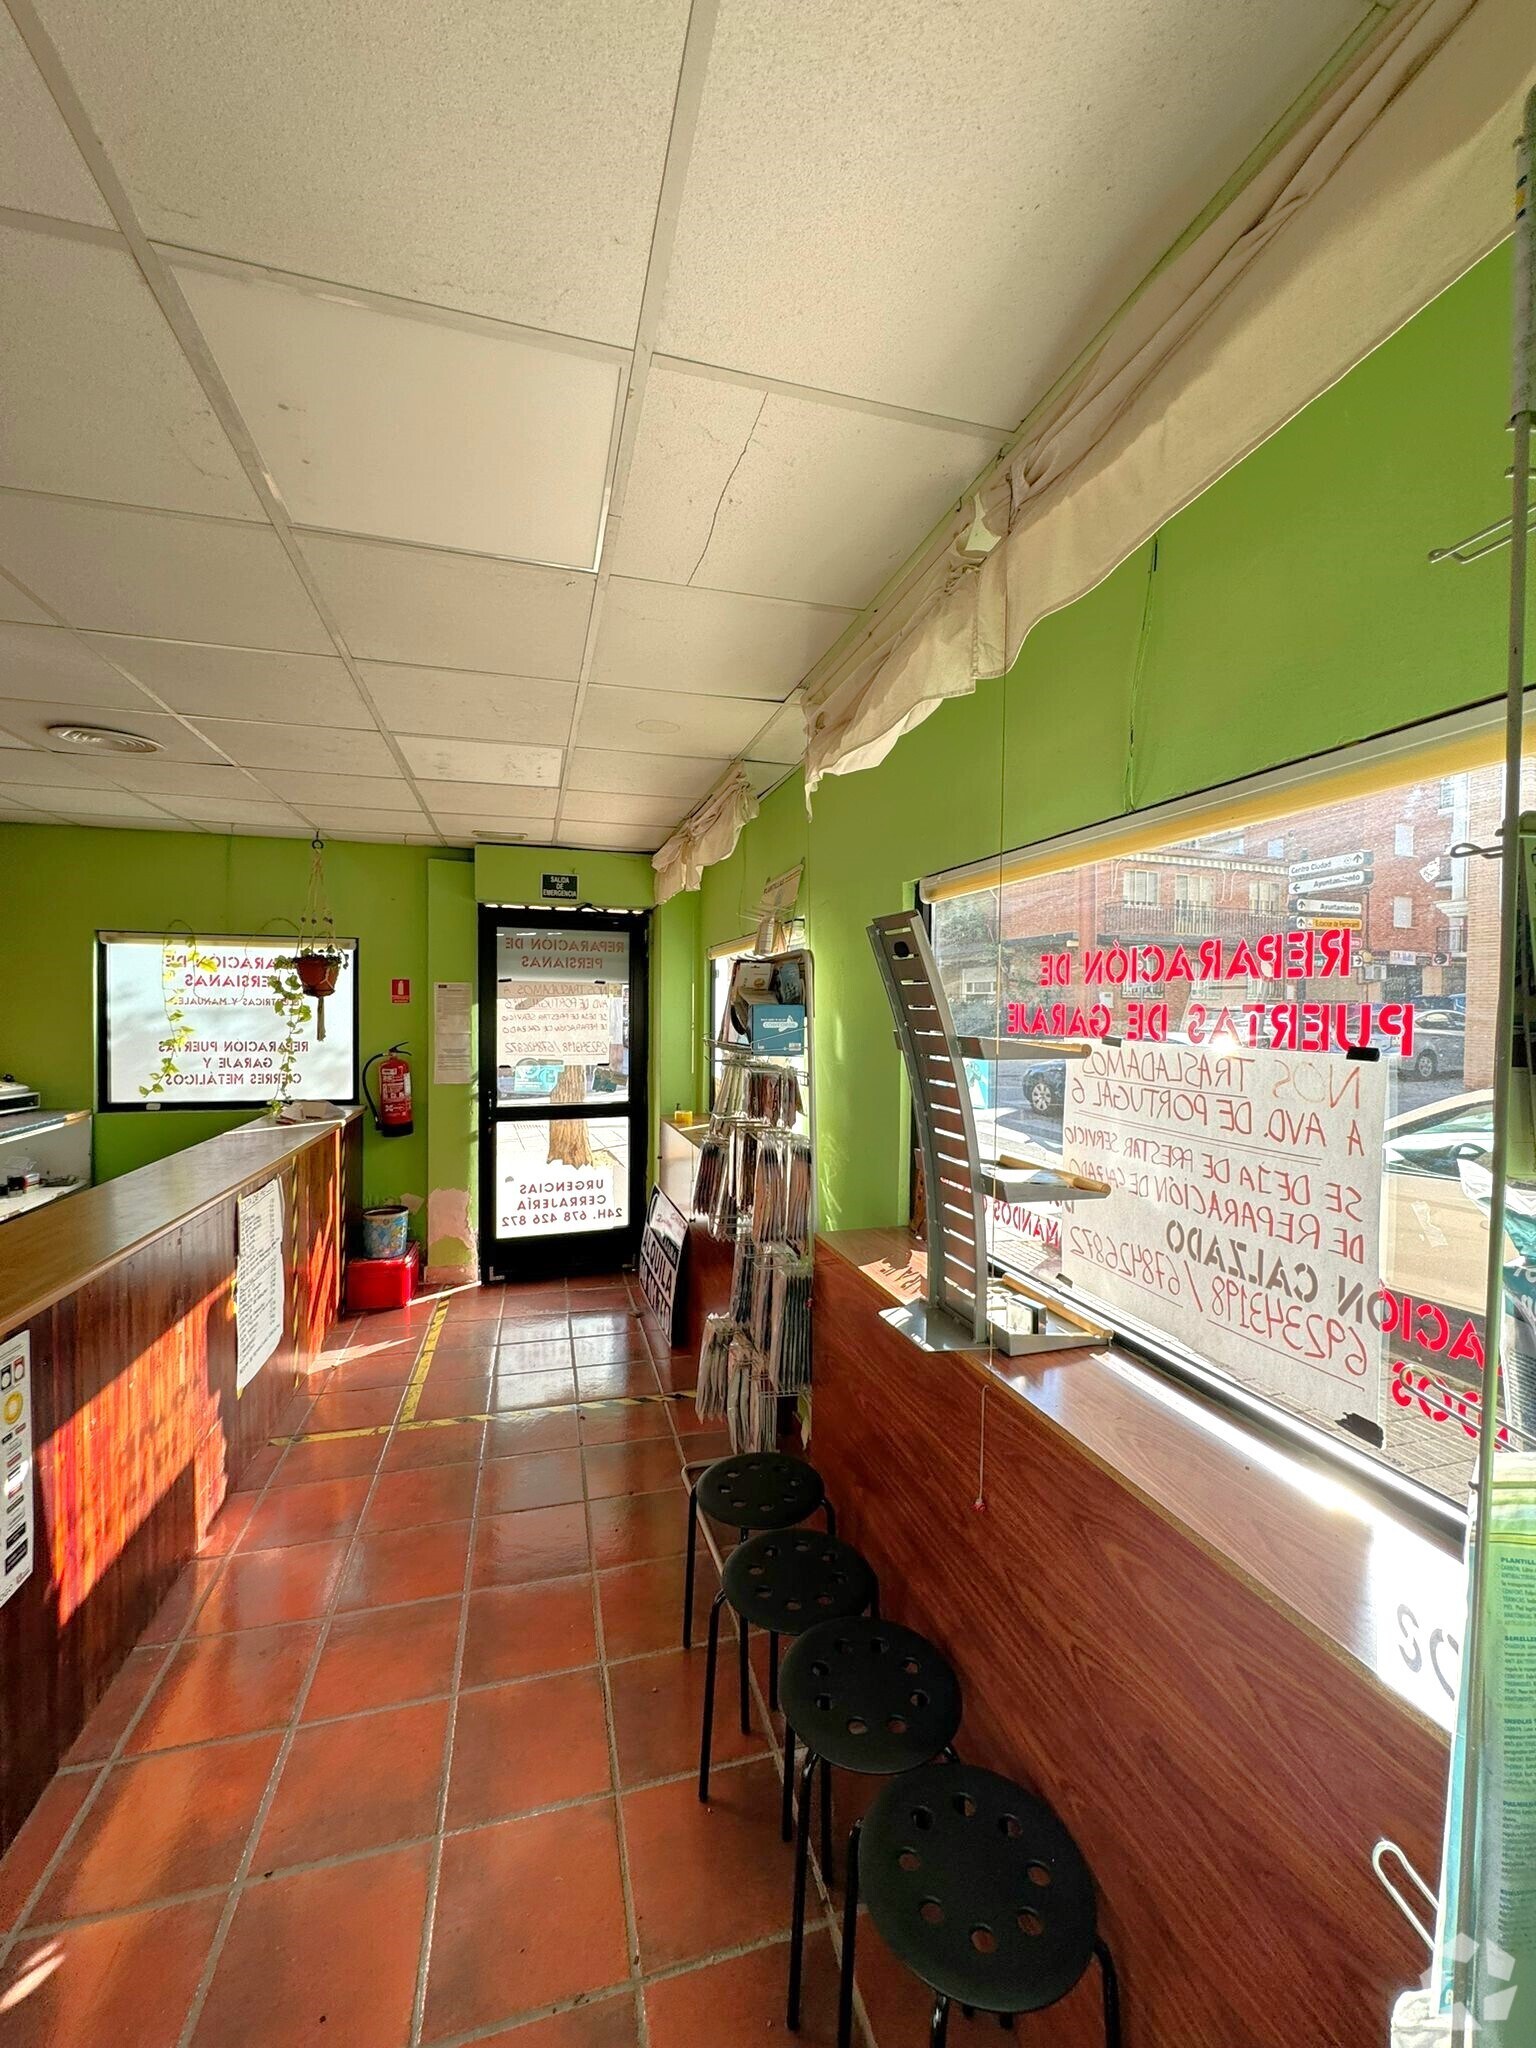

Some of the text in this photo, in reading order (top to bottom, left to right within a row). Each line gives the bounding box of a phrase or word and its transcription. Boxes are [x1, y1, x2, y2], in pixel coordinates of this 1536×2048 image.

[1311, 860, 1332, 871] Ciudad
[550, 876, 570, 884] SALIDA
[543, 889, 577, 898] EMERGENCIA
[1320, 903, 1360, 912] Ayuntamiento
[643, 1229, 673, 1299] ALQUILA
[1500, 1557, 1536, 1566] PLANTILL
